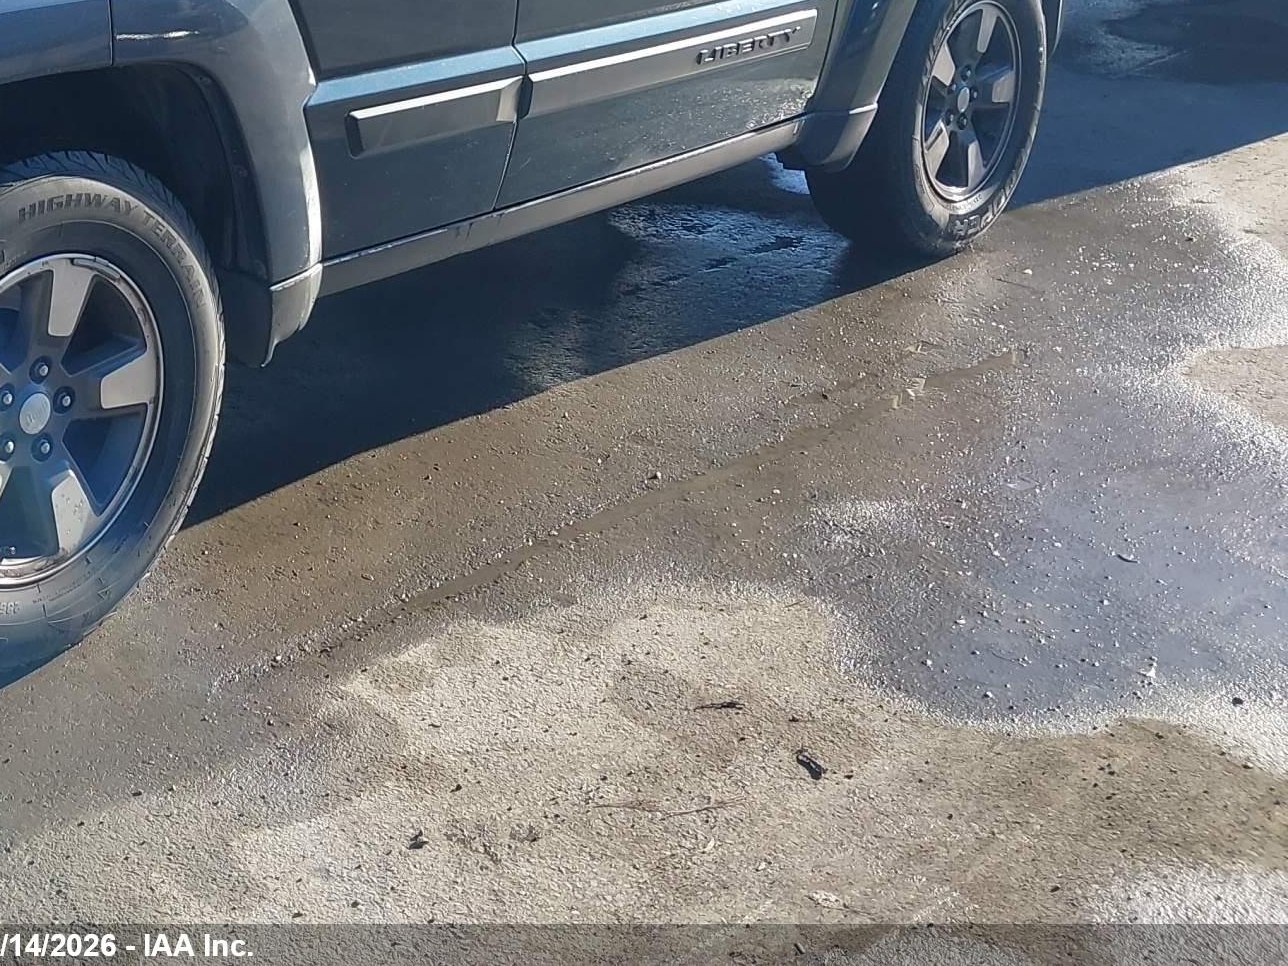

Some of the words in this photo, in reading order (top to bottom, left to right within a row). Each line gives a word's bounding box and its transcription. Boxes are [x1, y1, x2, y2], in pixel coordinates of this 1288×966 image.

[696, 25, 802, 65] LIBERTY
[18, 192, 139, 222] HIGHWAY
[142, 210, 207, 309] TERRAIN
